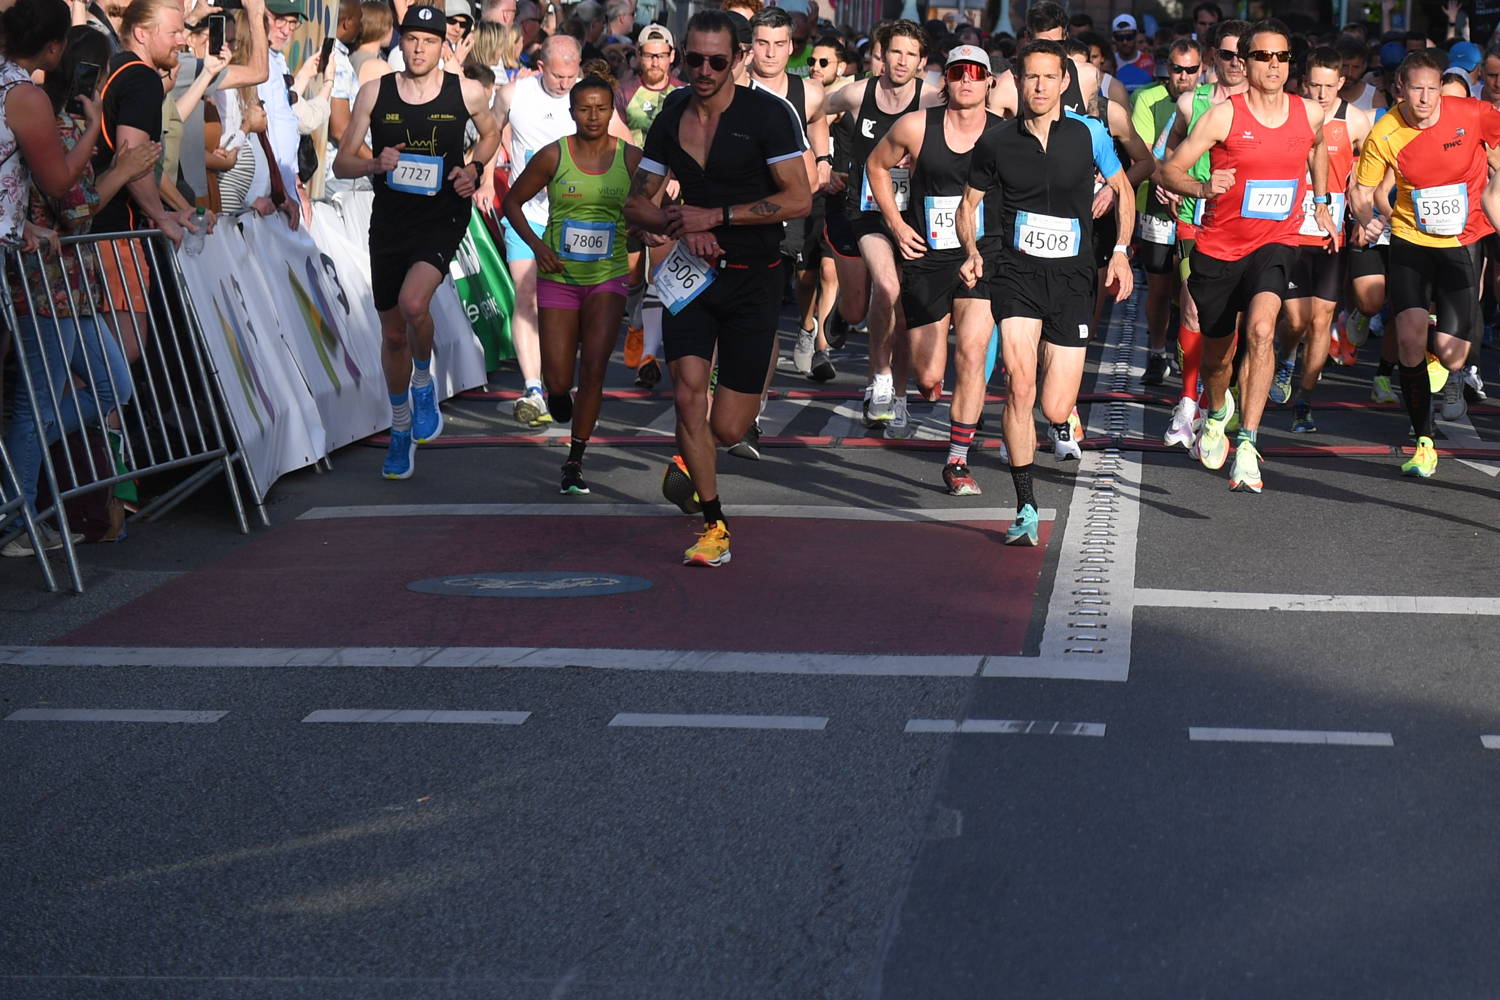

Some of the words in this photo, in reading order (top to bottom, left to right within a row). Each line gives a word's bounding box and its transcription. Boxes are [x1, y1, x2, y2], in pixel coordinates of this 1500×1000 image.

[400, 166, 431, 181] 7727
[1257, 193, 1288, 206] 7770
[1422, 199, 1460, 215] 5368
[573, 233, 603, 248] 7806
[1024, 231, 1069, 251] 4508
